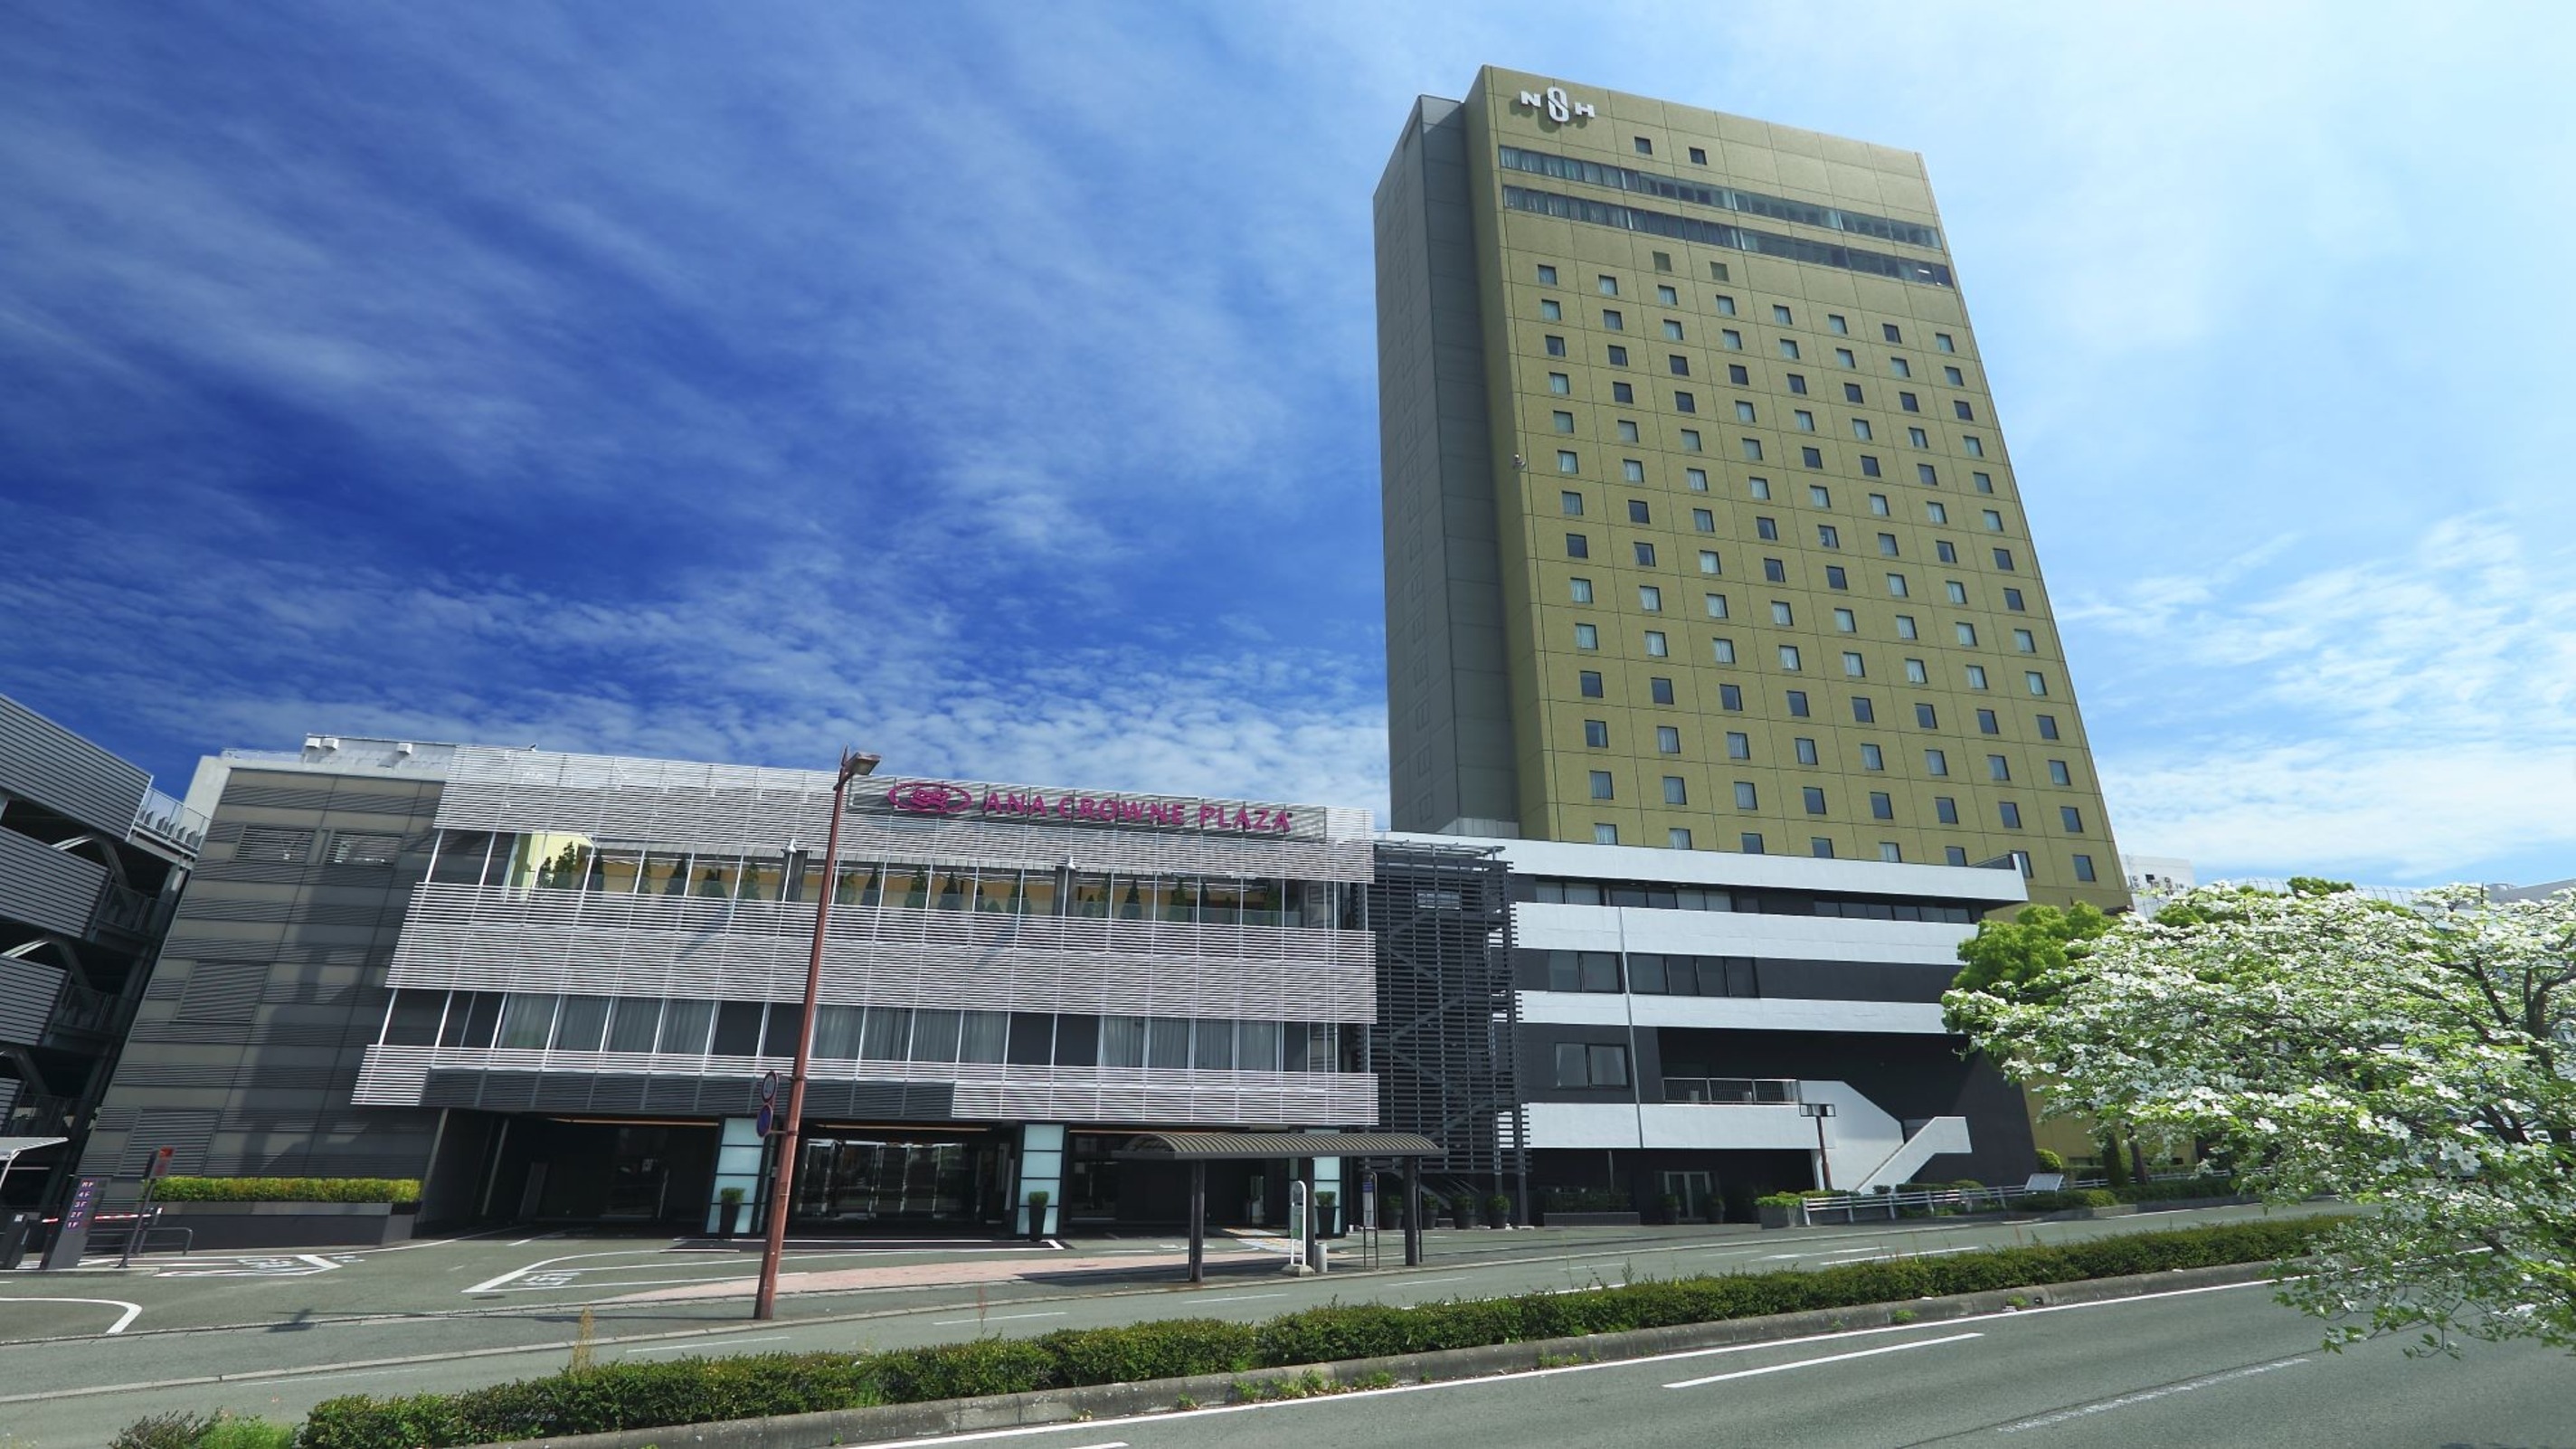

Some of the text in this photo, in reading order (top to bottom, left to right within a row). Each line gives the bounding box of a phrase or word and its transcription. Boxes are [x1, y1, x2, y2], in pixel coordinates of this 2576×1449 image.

[983, 792, 1291, 832] ANA CROWNE PLAZA
